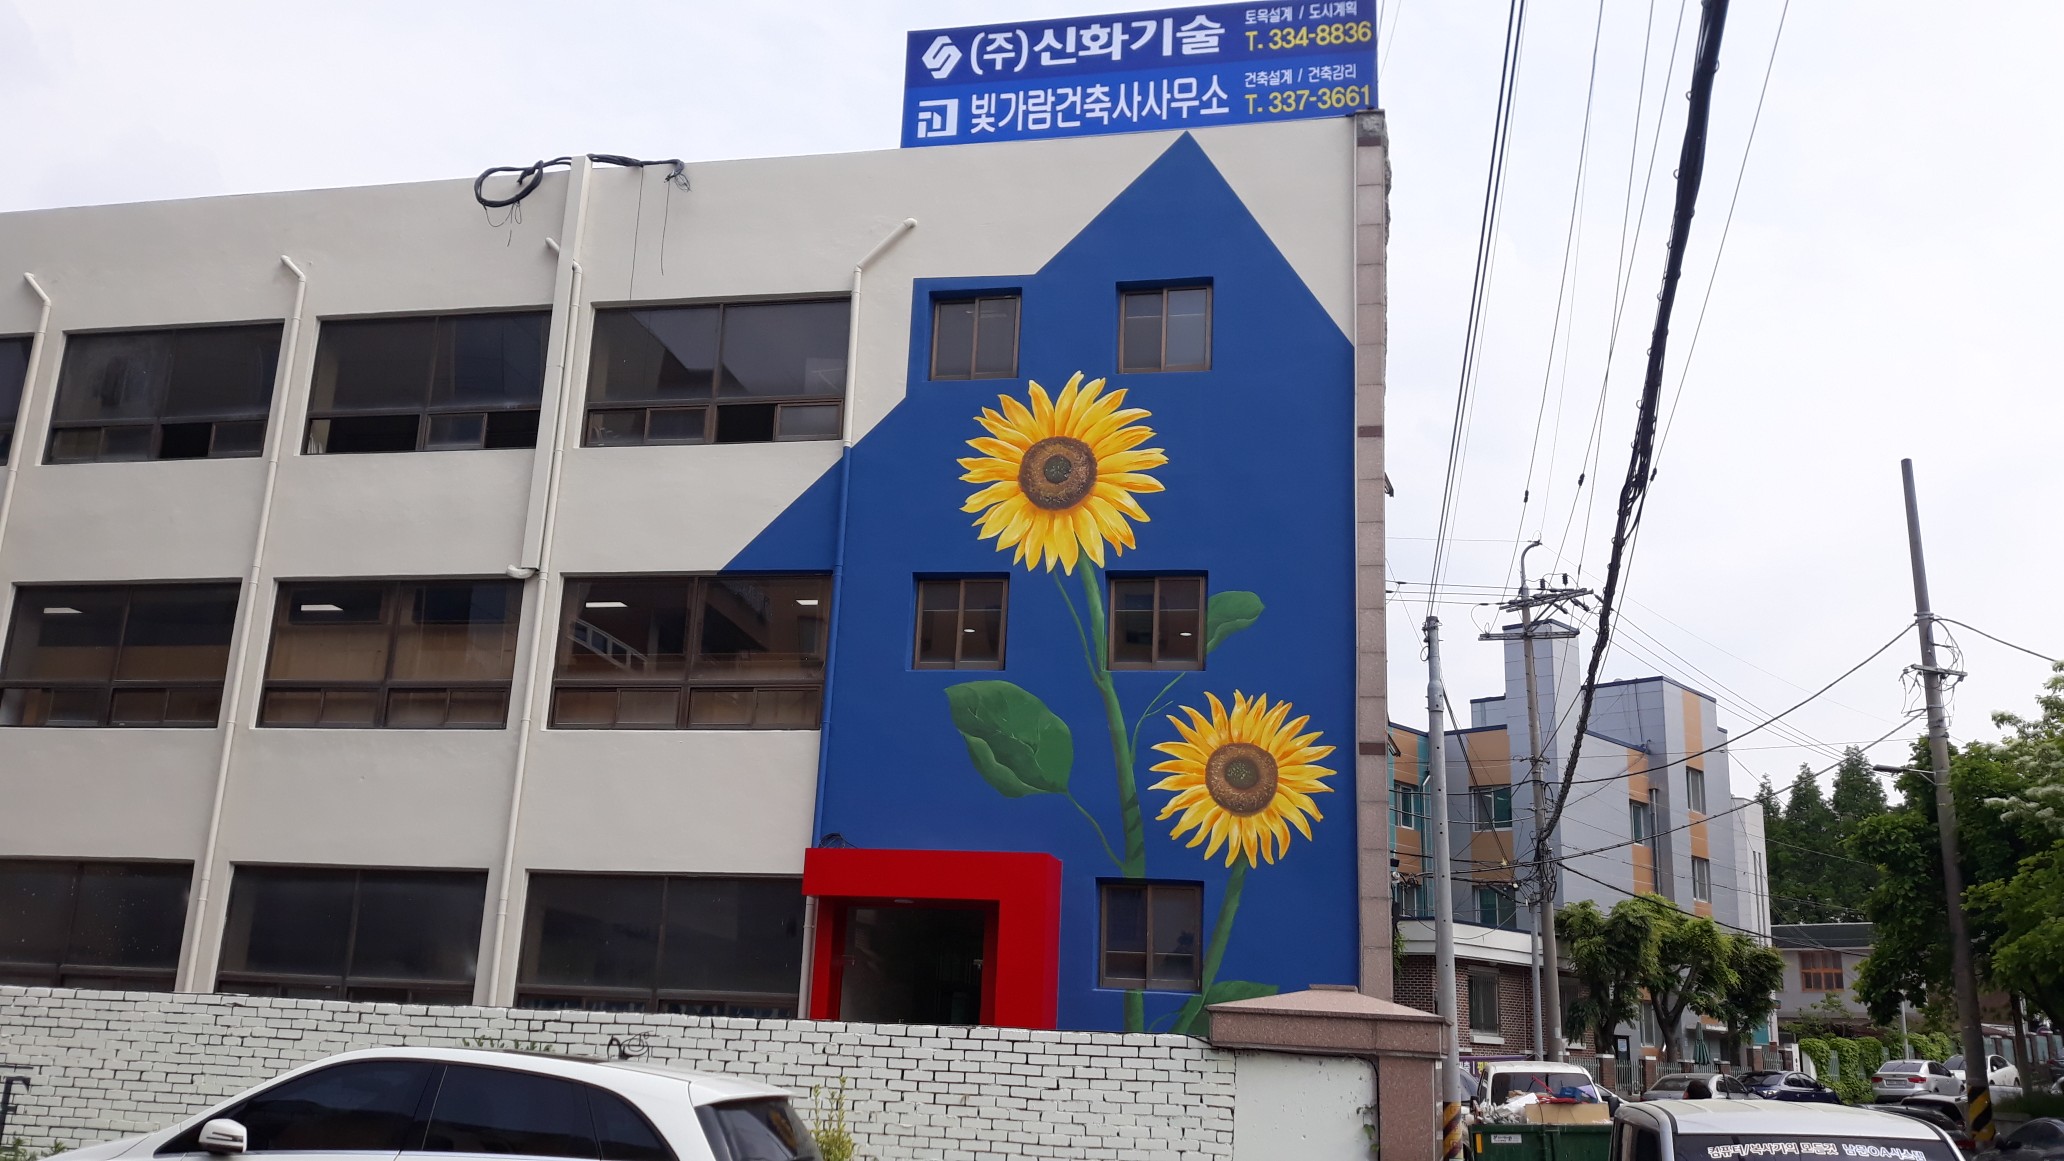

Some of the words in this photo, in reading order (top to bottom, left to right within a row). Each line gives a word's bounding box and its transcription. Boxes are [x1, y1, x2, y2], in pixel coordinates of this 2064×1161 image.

[1244, 6, 1293, 25] 토목설계
[1308, 1, 1358, 19] 도시계획
[1268, 20, 1372, 50] 334-8836
[1244, 68, 1293, 88] 건축설계
[1307, 63, 1357, 83] 건축감리
[970, 74, 1230, 134] 빛가람건축사사무소
[1268, 84, 1371, 113] 337-3661
